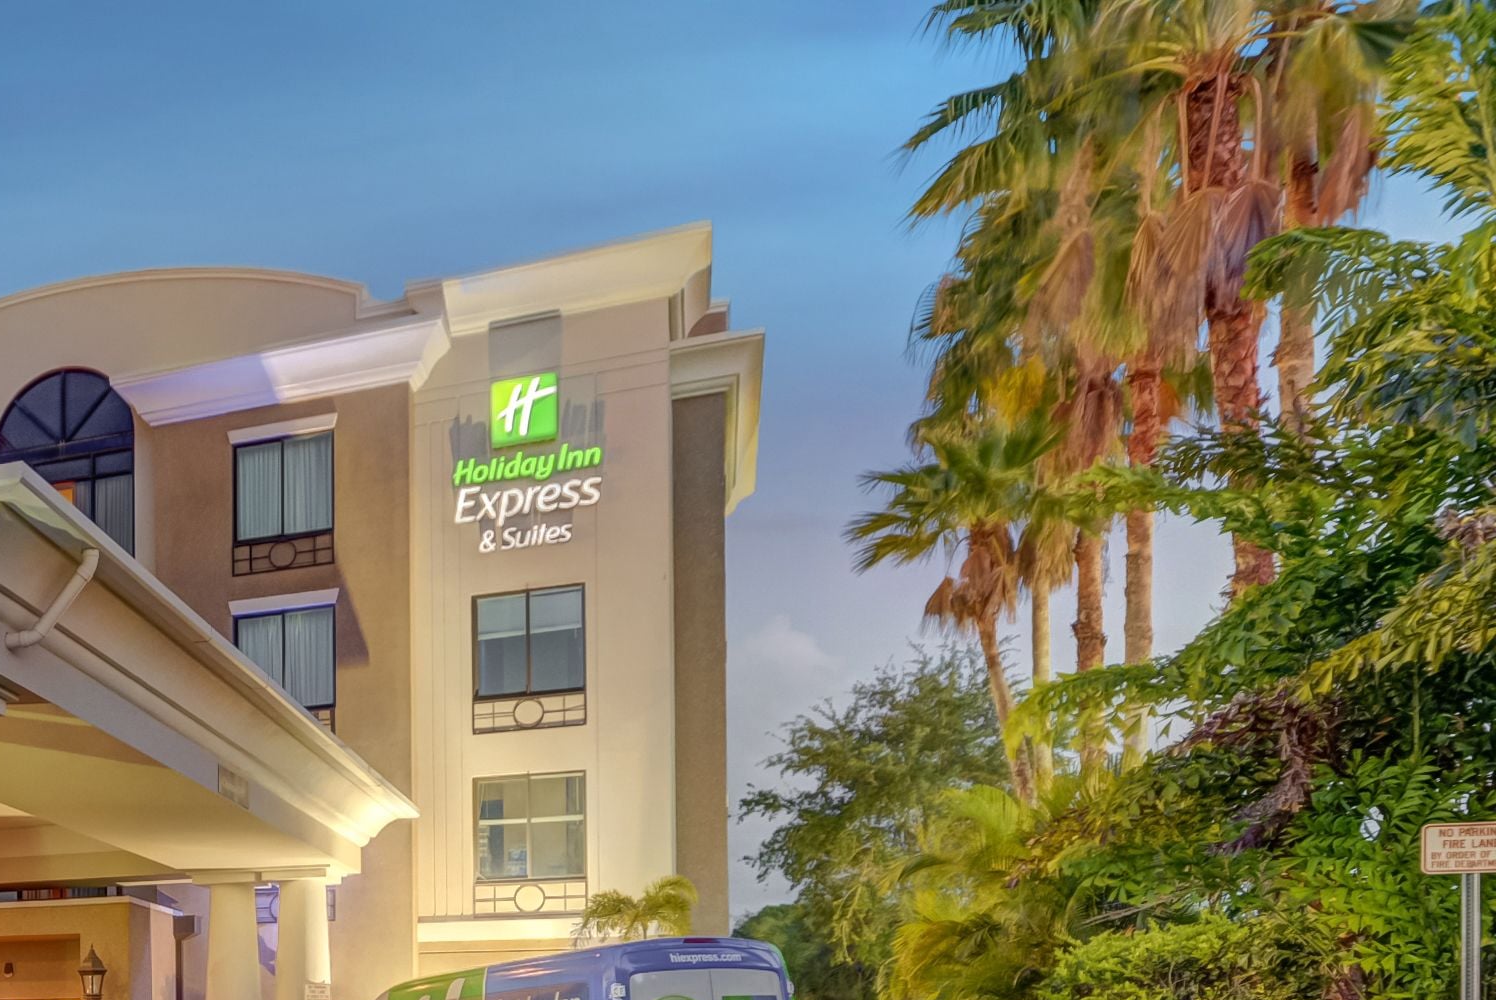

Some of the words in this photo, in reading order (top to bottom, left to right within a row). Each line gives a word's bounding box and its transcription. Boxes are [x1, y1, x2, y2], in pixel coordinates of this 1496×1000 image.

[452, 451, 555, 486] Holiday
[557, 443, 601, 472] Inn
[454, 476, 602, 527] Express
[479, 529, 496, 553] &
[501, 523, 573, 551] Suites
[1439, 828, 1454, 837] NO
[1459, 827, 1496, 837] PARKIN
[1442, 839, 1466, 848] FIRE
[1431, 851, 1442, 860] BY
[1446, 851, 1476, 859] ORDER
[1480, 850, 1492, 858] OF
[1431, 860, 1449, 868] FIRE
[669, 952, 743, 965] hiexpress.com
